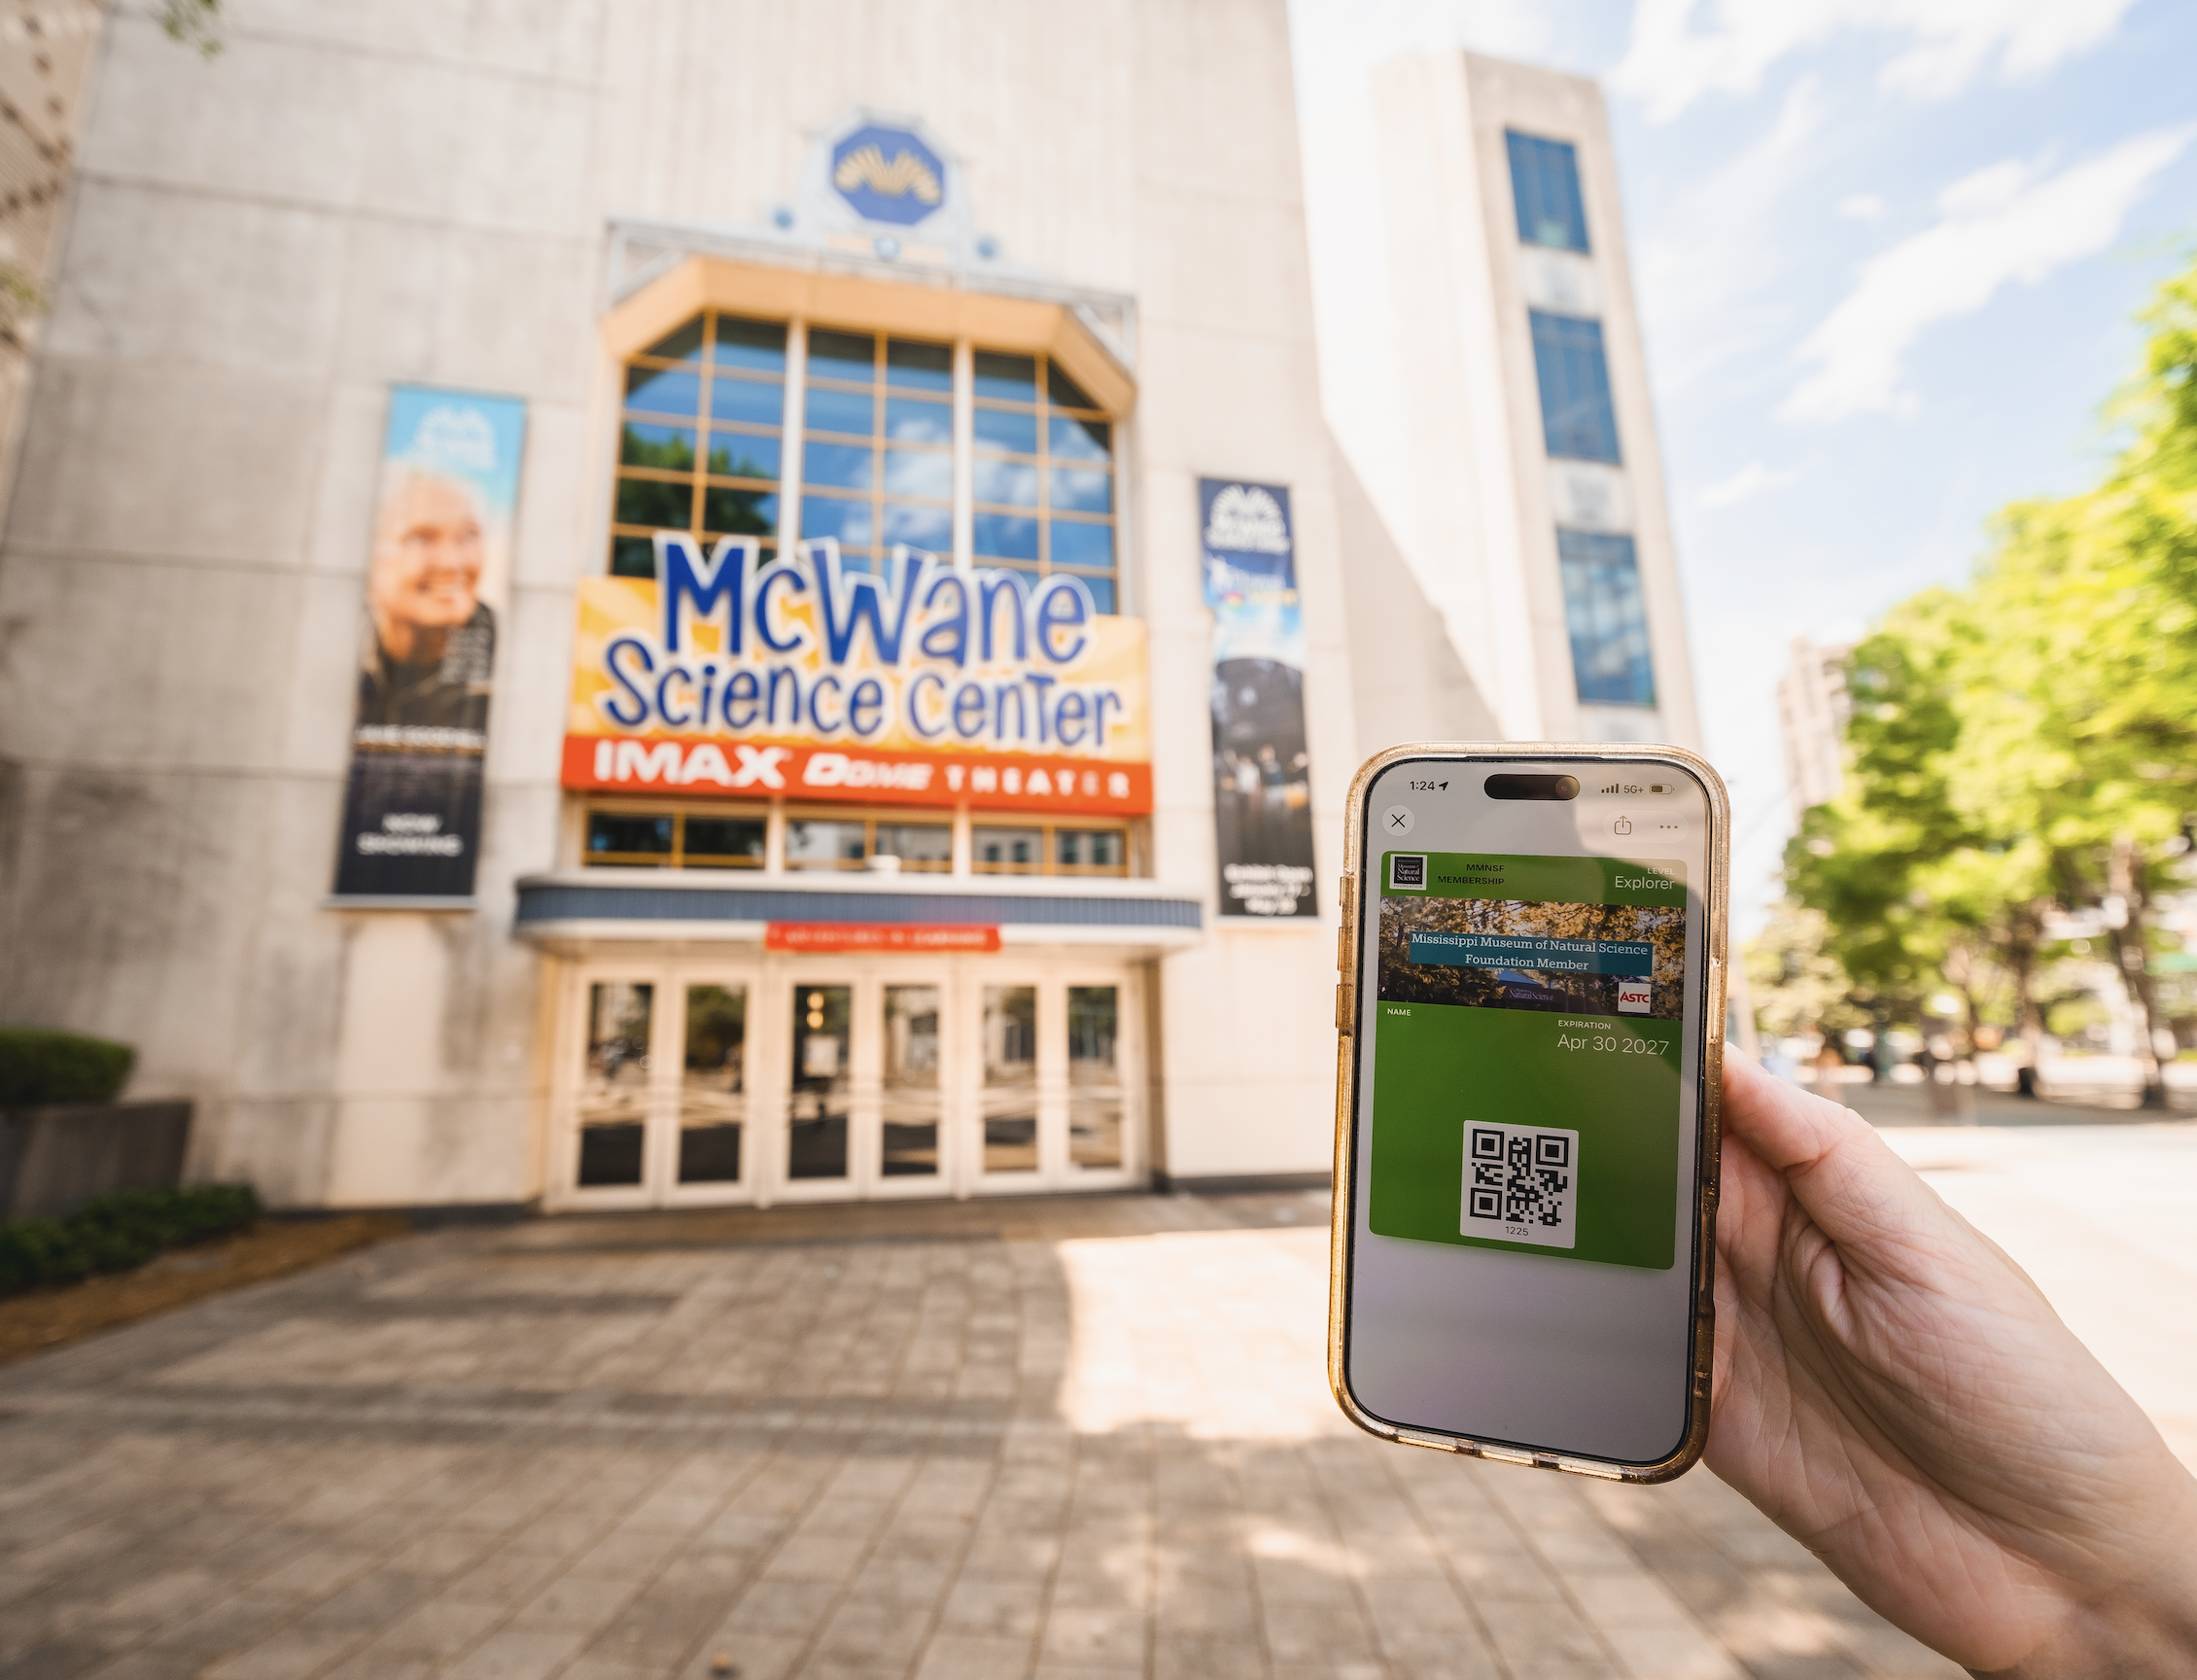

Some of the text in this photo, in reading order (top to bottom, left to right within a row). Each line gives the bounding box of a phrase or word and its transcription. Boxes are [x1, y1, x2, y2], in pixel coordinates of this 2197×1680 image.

[656, 533, 1091, 670] McWane
[603, 637, 887, 739] Science
[593, 739, 787, 789] IMAX
[945, 764, 1131, 800] THEATER
[1410, 781, 1644, 794] 1:24 5G+
[1466, 863, 1505, 873] MMNSF
[1438, 875, 1505, 886] MEMBERSHIP
[1615, 875, 1675, 891] Explorer
[1412, 933, 1648, 956] Mississippi Museum of Natural Science
[1465, 954, 1589, 970] Foundation Member
[1621, 991, 1650, 1003] ASTC
[1387, 1007, 1412, 1016] NAME
[1557, 1020, 1612, 1030] EXPIRATION
[1557, 1033, 1670, 1056] Apr 30 2027
[1505, 1225, 1529, 1236] 1225
